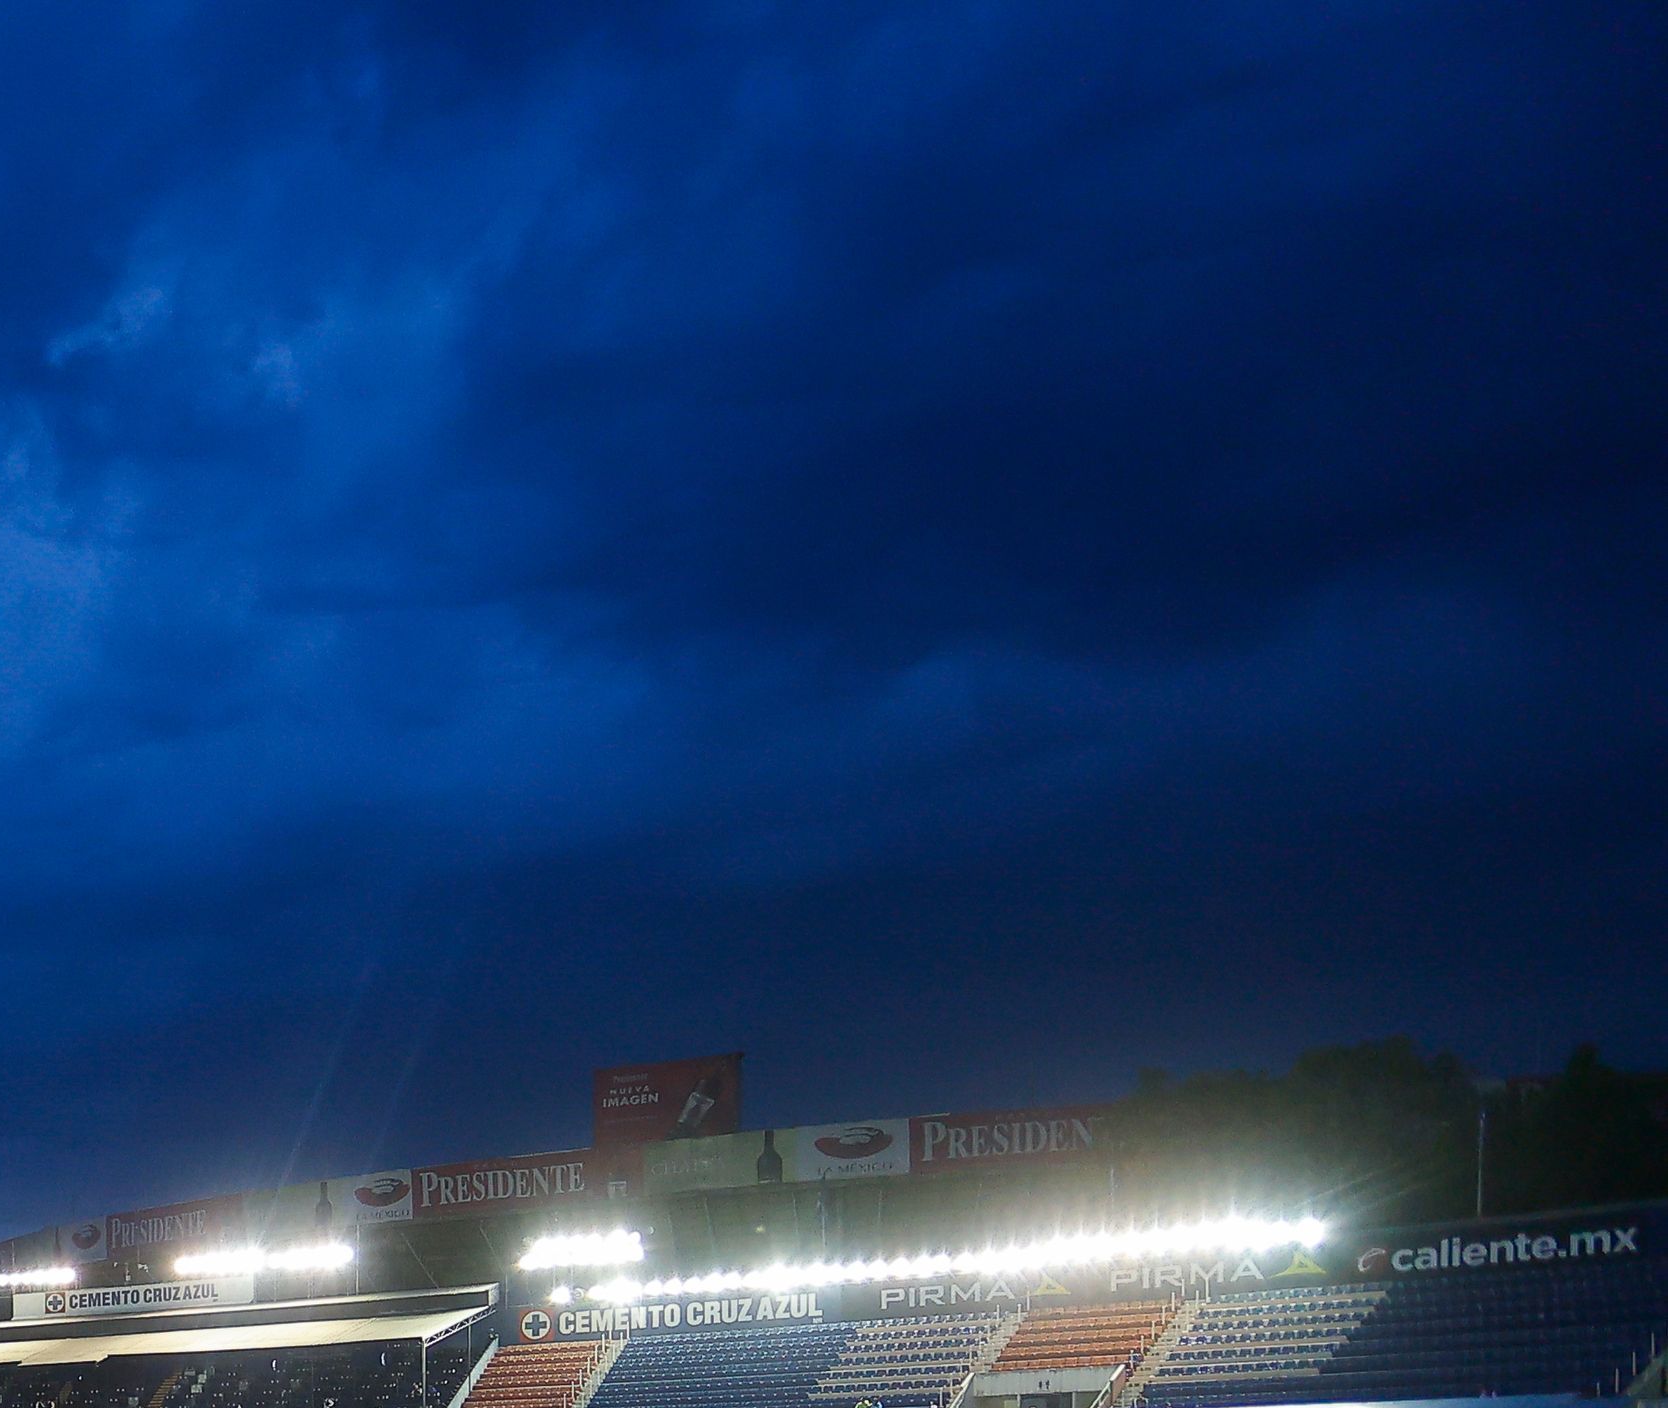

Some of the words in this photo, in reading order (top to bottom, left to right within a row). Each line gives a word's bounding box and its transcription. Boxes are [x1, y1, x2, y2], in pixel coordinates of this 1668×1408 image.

[602, 1092, 659, 1108] IMAGEN
[419, 1162, 584, 1208] PRESIDENTE
[1390, 1227, 1638, 1272] caliente.mx
[1111, 1256, 1265, 1292] PIRMA
[69, 1289, 140, 1310] CEMENTO
[144, 1287, 182, 1304] CRUZ
[183, 1283, 220, 1301] AZUL
[880, 1279, 1017, 1311] PIRMA
[560, 1305, 683, 1335] CEMENTO
[686, 1298, 755, 1327] CRUZ
[756, 1293, 824, 1323] AZUL
